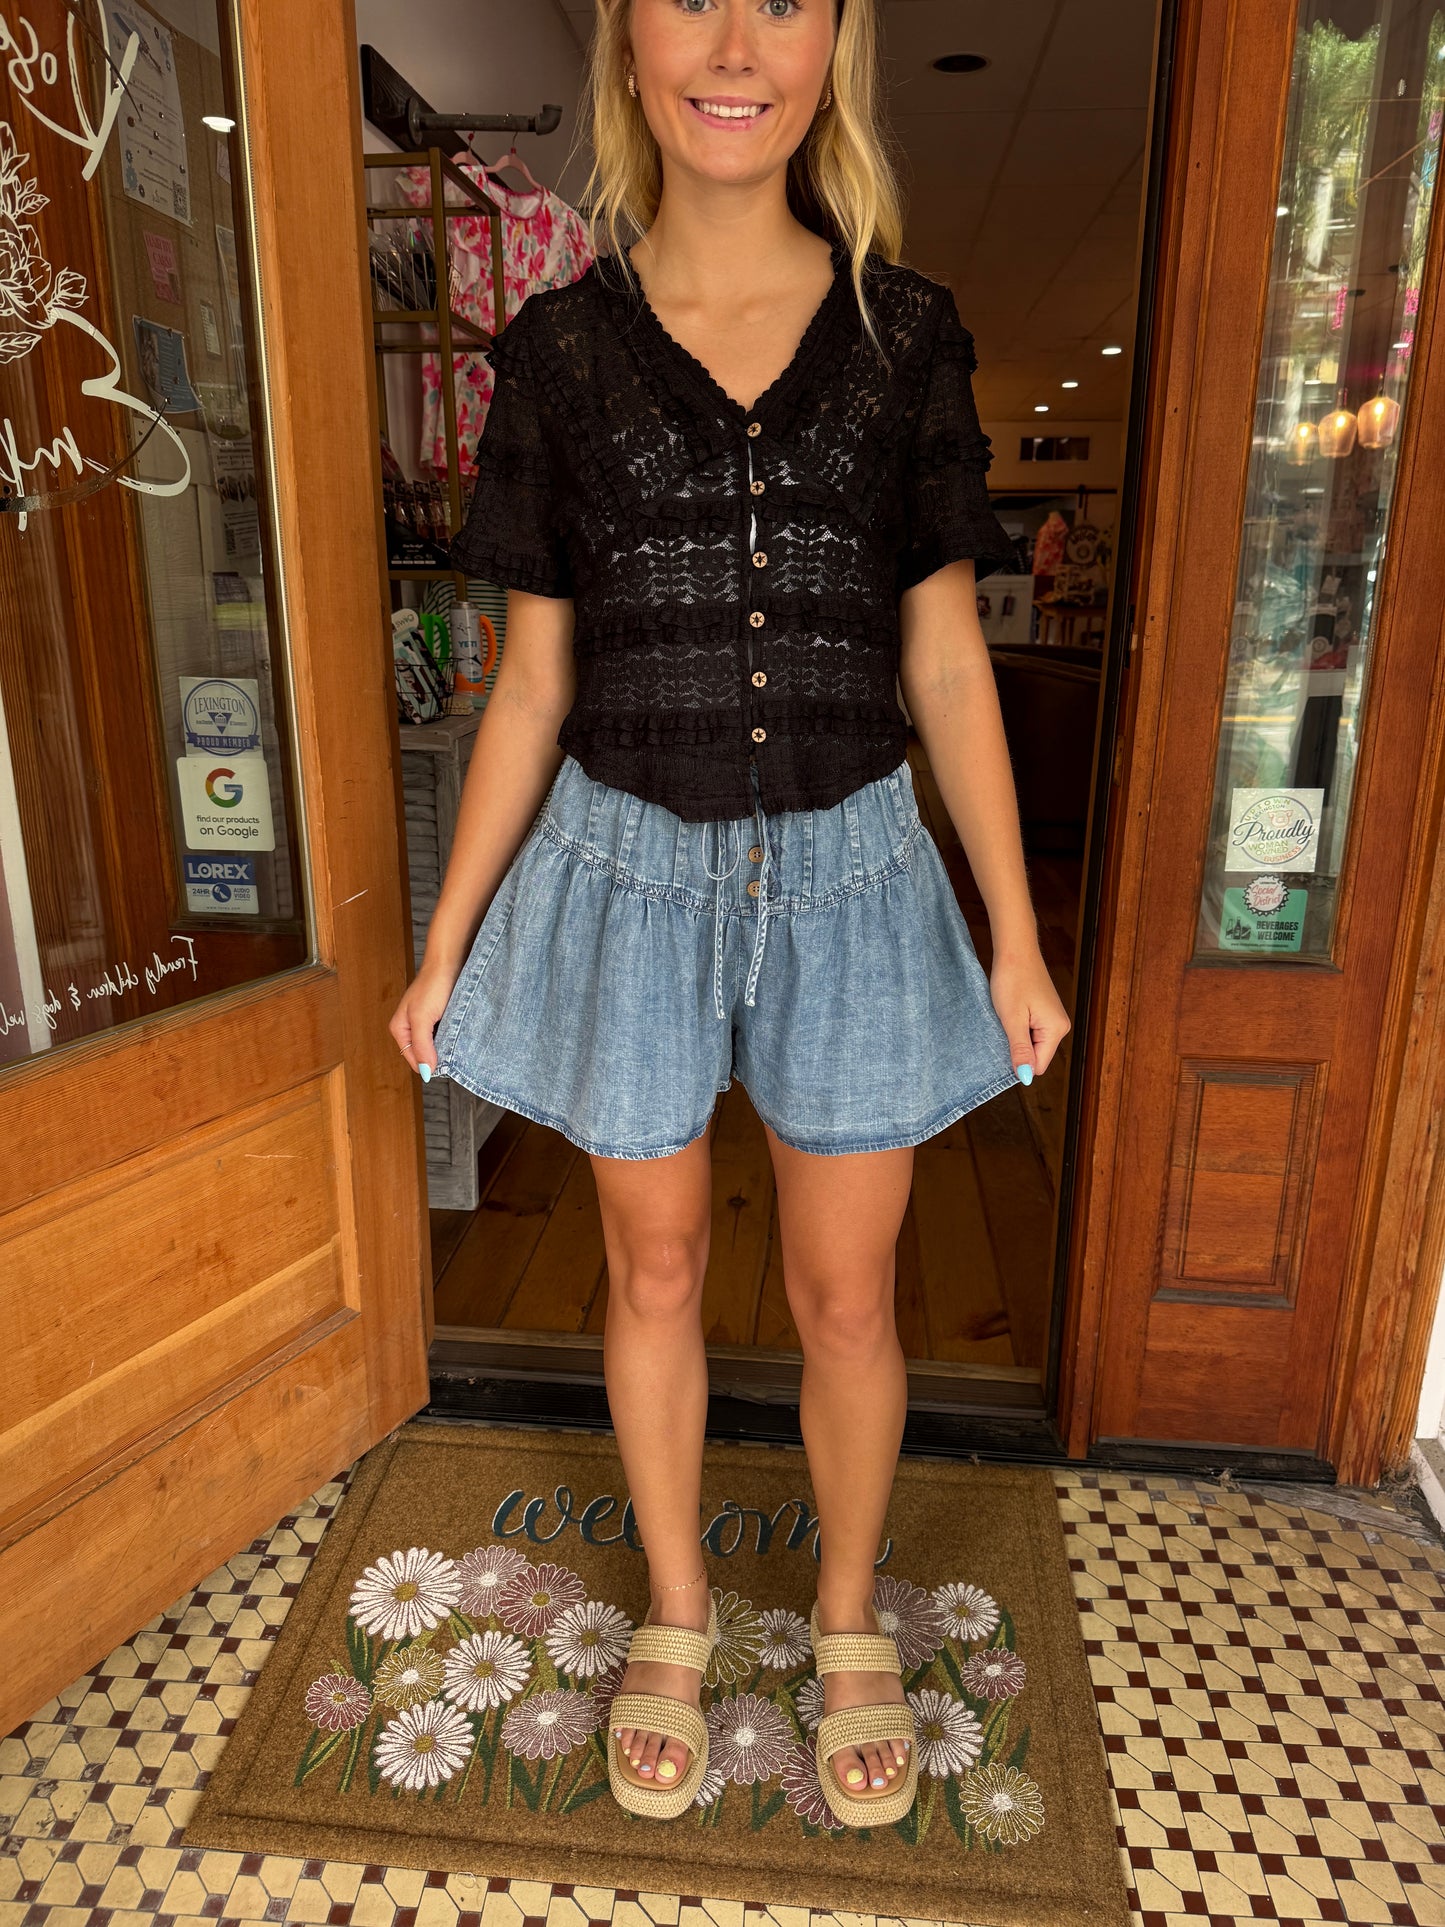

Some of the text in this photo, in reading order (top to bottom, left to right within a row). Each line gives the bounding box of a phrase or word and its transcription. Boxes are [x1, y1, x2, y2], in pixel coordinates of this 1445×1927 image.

[194, 697, 246, 716] LEXINGTON
[197, 737, 251, 747] PROUD MEMBER
[1244, 799, 1291, 821] UPTOWN
[1252, 804, 1286, 820] LEXINGTON
[196, 814, 211, 823] find
[226, 816, 260, 824] products
[200, 825, 259, 839] on Google
[1232, 819, 1316, 846] Proudly
[1248, 840, 1289, 851] WOMAN
[1255, 847, 1289, 856] OWNED
[1263, 845, 1302, 862] BUSINESS
[187, 862, 250, 880] LOREX
[1252, 884, 1279, 897] Social
[1253, 894, 1282, 907] District
[1256, 921, 1299, 931] BEVERAGES
[1257, 931, 1296, 941] WELCOME
